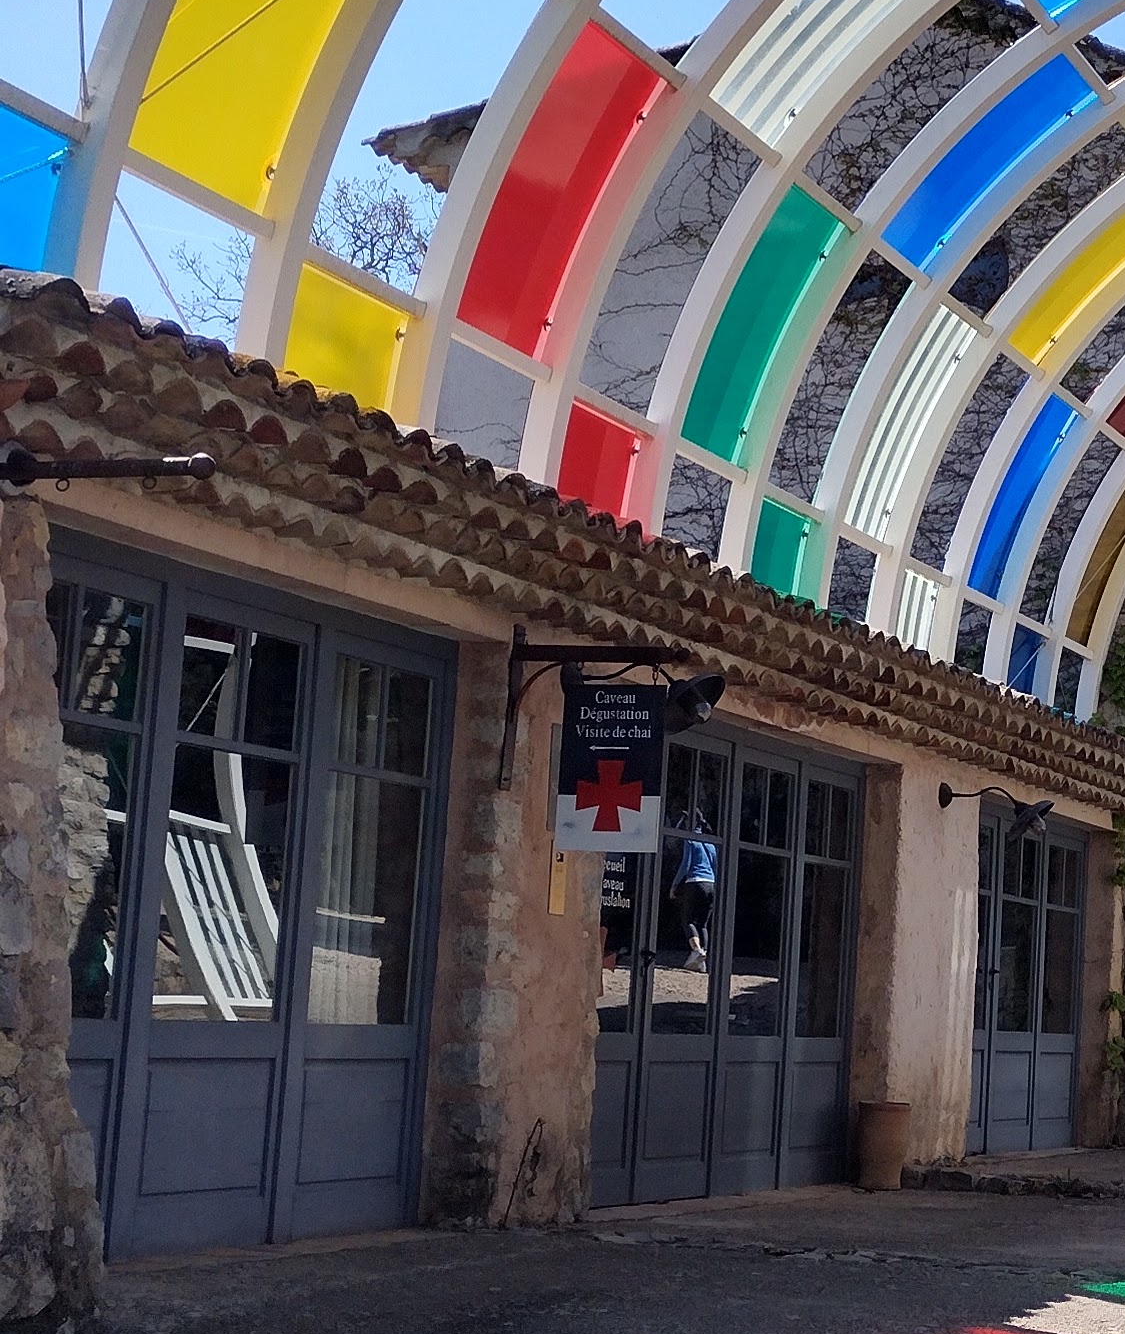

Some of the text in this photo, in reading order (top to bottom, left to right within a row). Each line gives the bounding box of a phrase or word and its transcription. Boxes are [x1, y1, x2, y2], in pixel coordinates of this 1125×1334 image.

[595, 690, 636, 704] Caveau
[580, 706, 649, 723] Dégustation
[576, 724, 651, 738] Visite de chai
[603, 856, 626, 873] cueil
[602, 878, 624, 891] aveau
[601, 890, 631, 909] ustation
